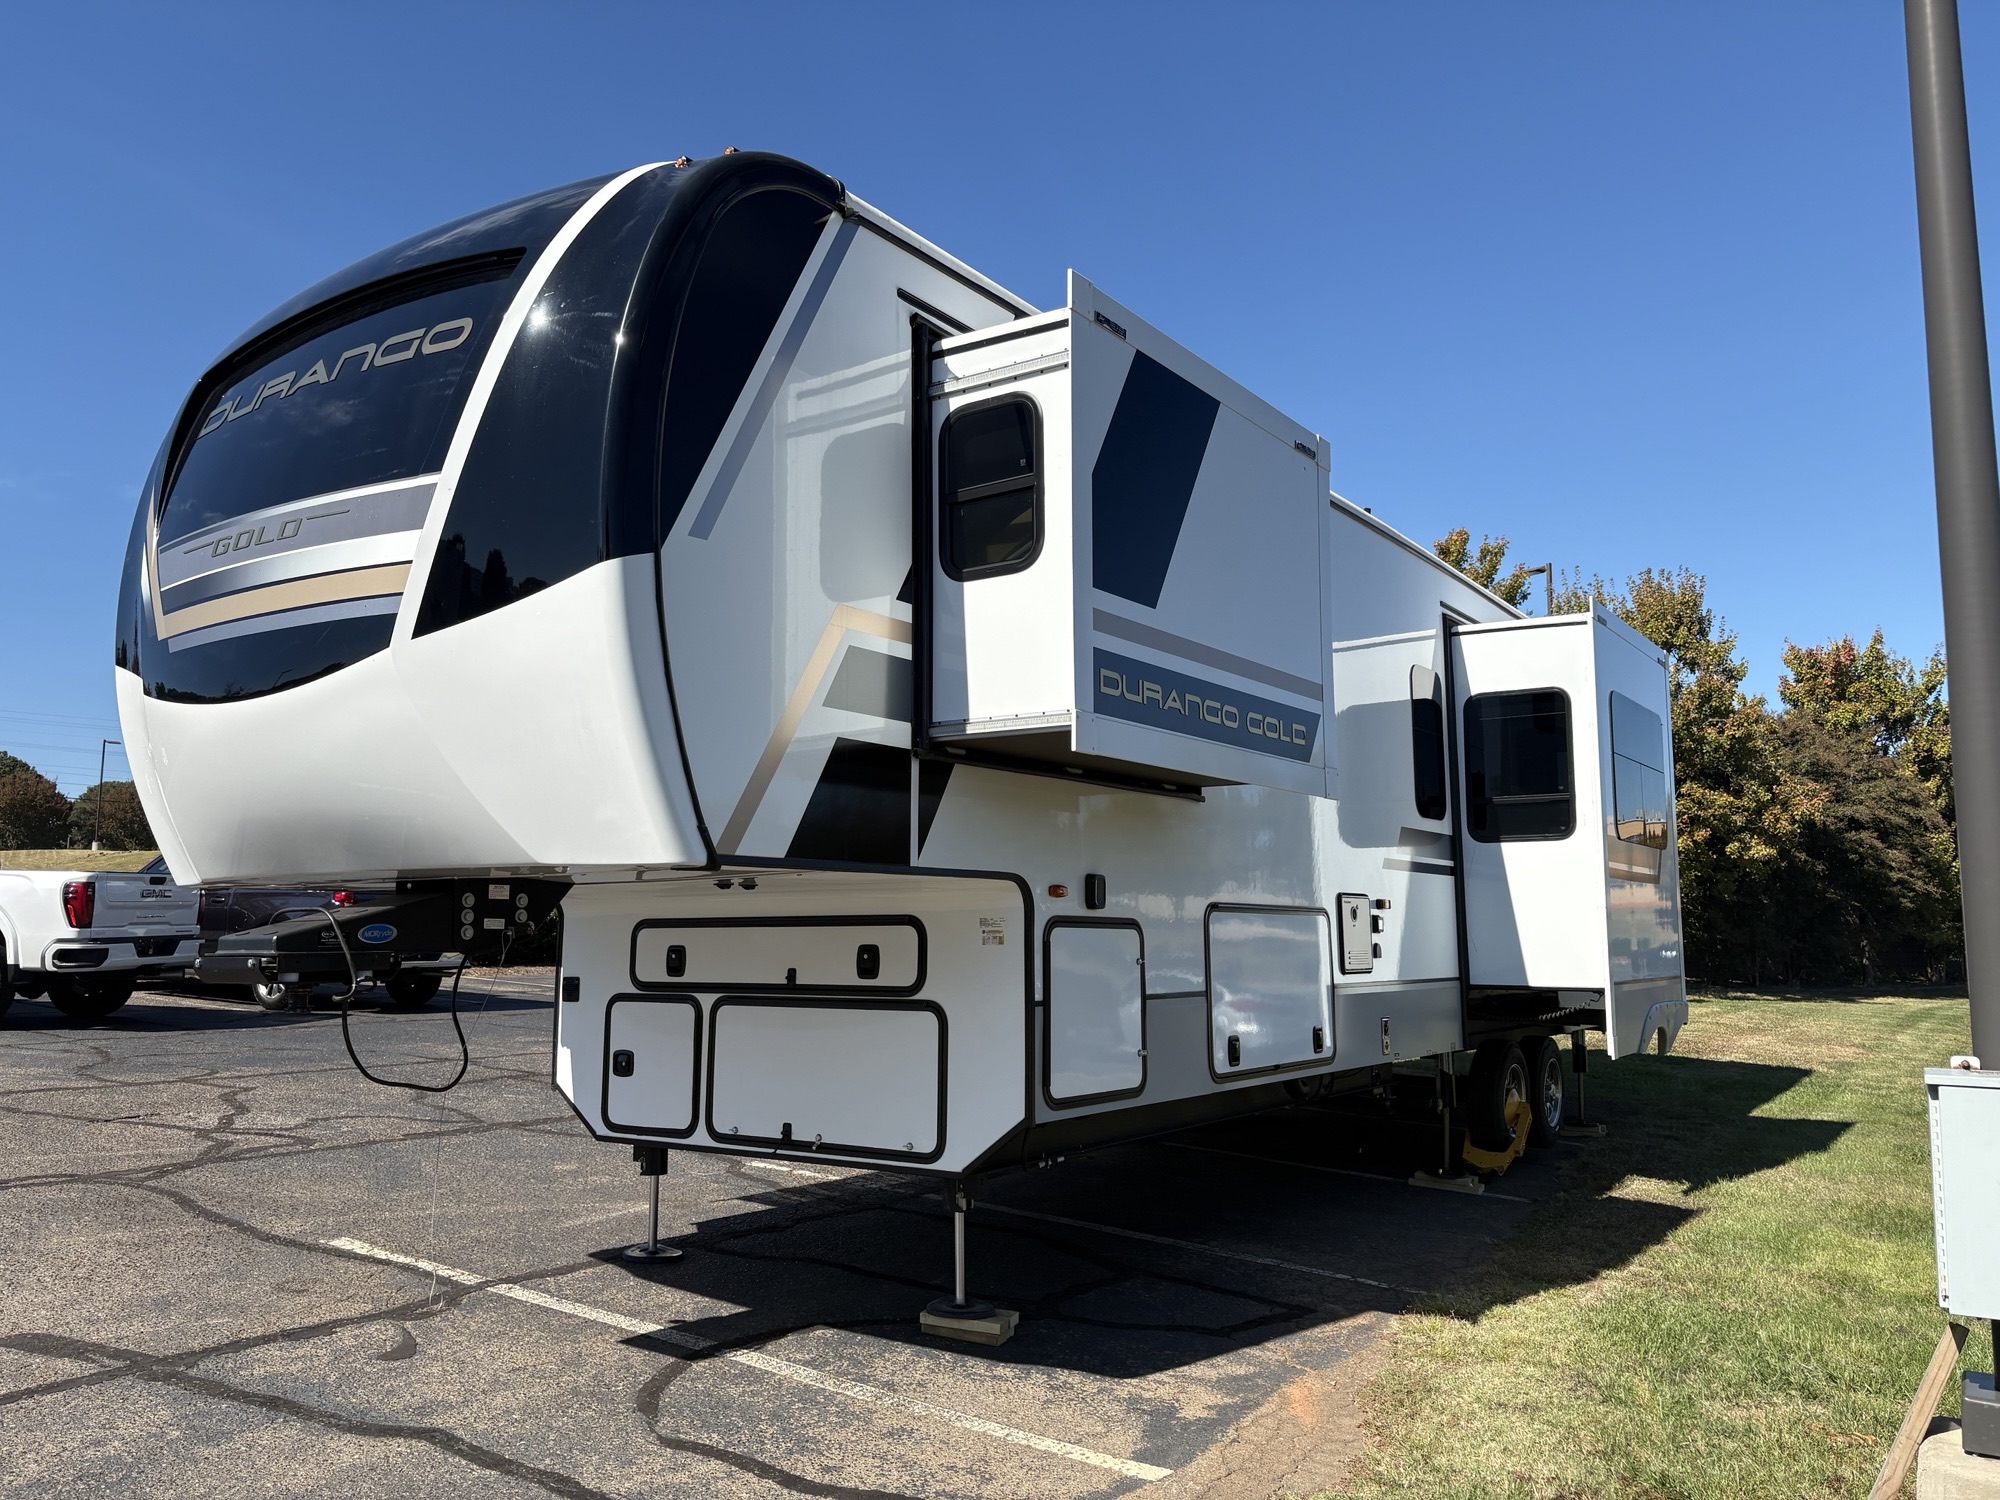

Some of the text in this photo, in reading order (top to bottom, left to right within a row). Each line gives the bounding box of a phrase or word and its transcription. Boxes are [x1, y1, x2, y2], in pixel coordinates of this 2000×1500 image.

[196, 317, 473, 440] DURANGO
[211, 517, 303, 558] GOLD
[1099, 667, 1306, 746] DURANGO GOLD
[141, 889, 173, 898] GMC
